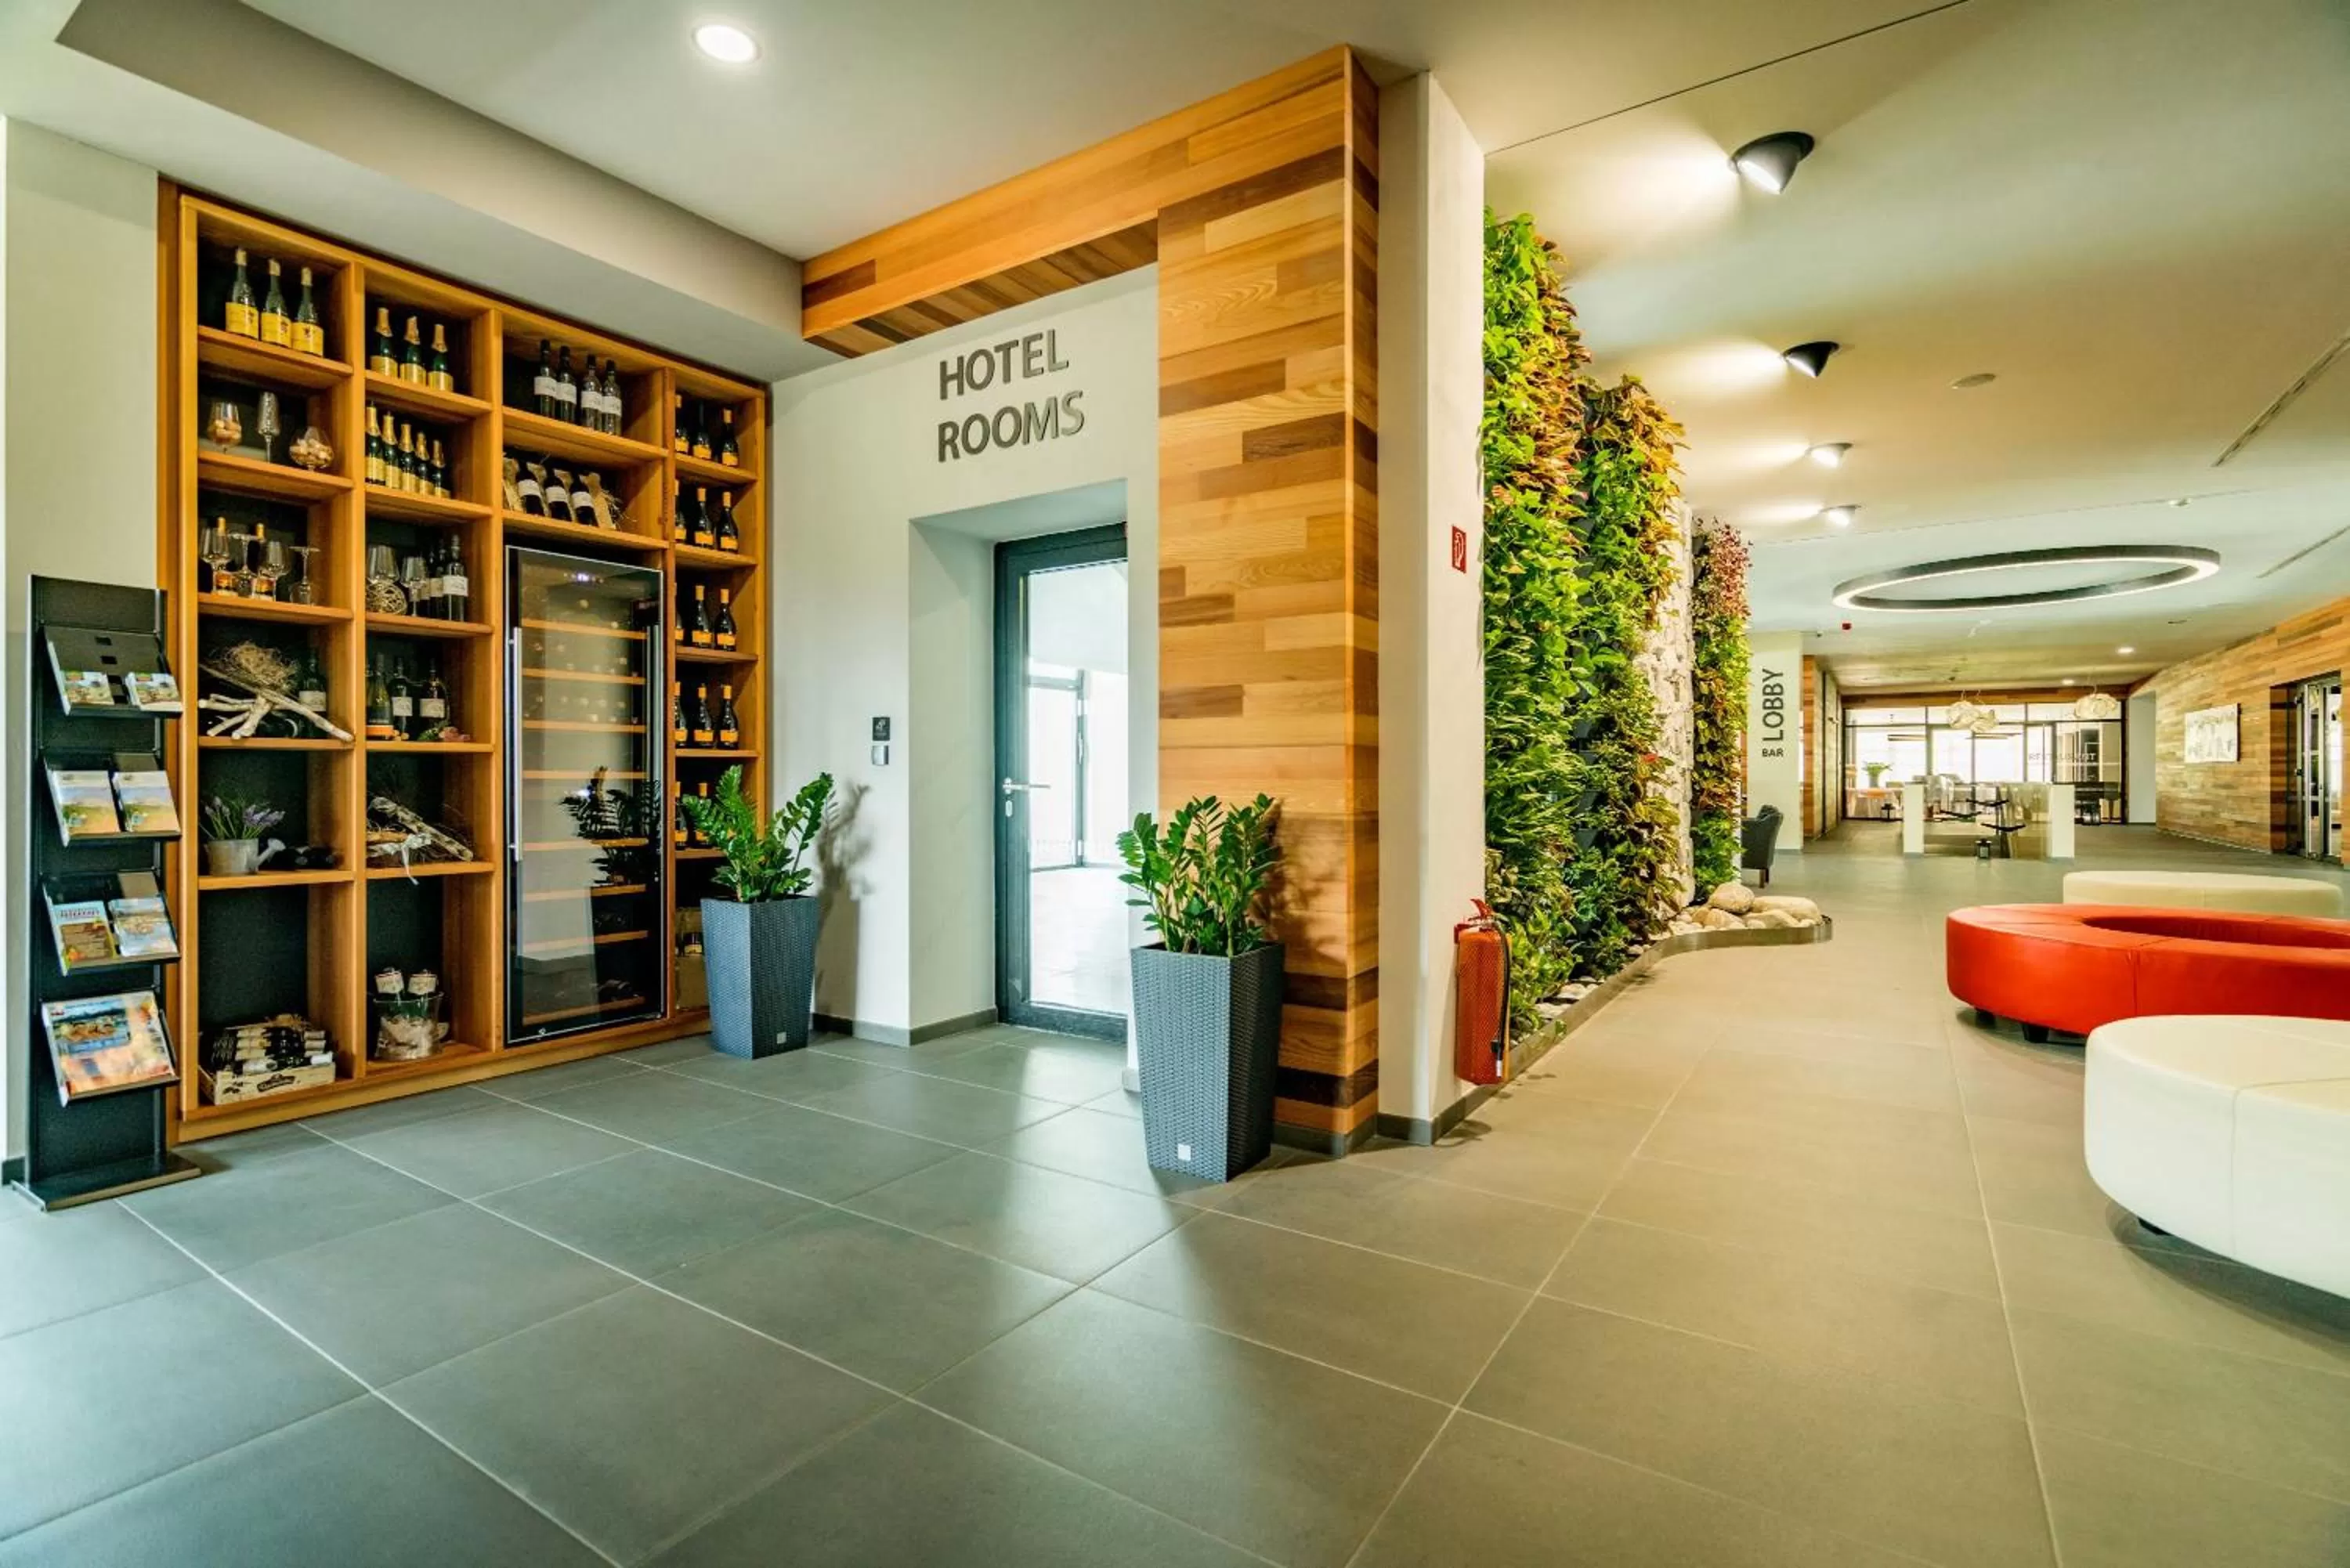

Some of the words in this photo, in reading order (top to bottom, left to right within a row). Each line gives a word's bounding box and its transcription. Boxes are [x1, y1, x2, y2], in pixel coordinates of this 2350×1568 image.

[940, 329, 1069, 400] HOTEL
[938, 390, 1085, 463] ROOMS
[1762, 668, 1784, 741] LOBBY
[1762, 748, 1784, 757] BAR
